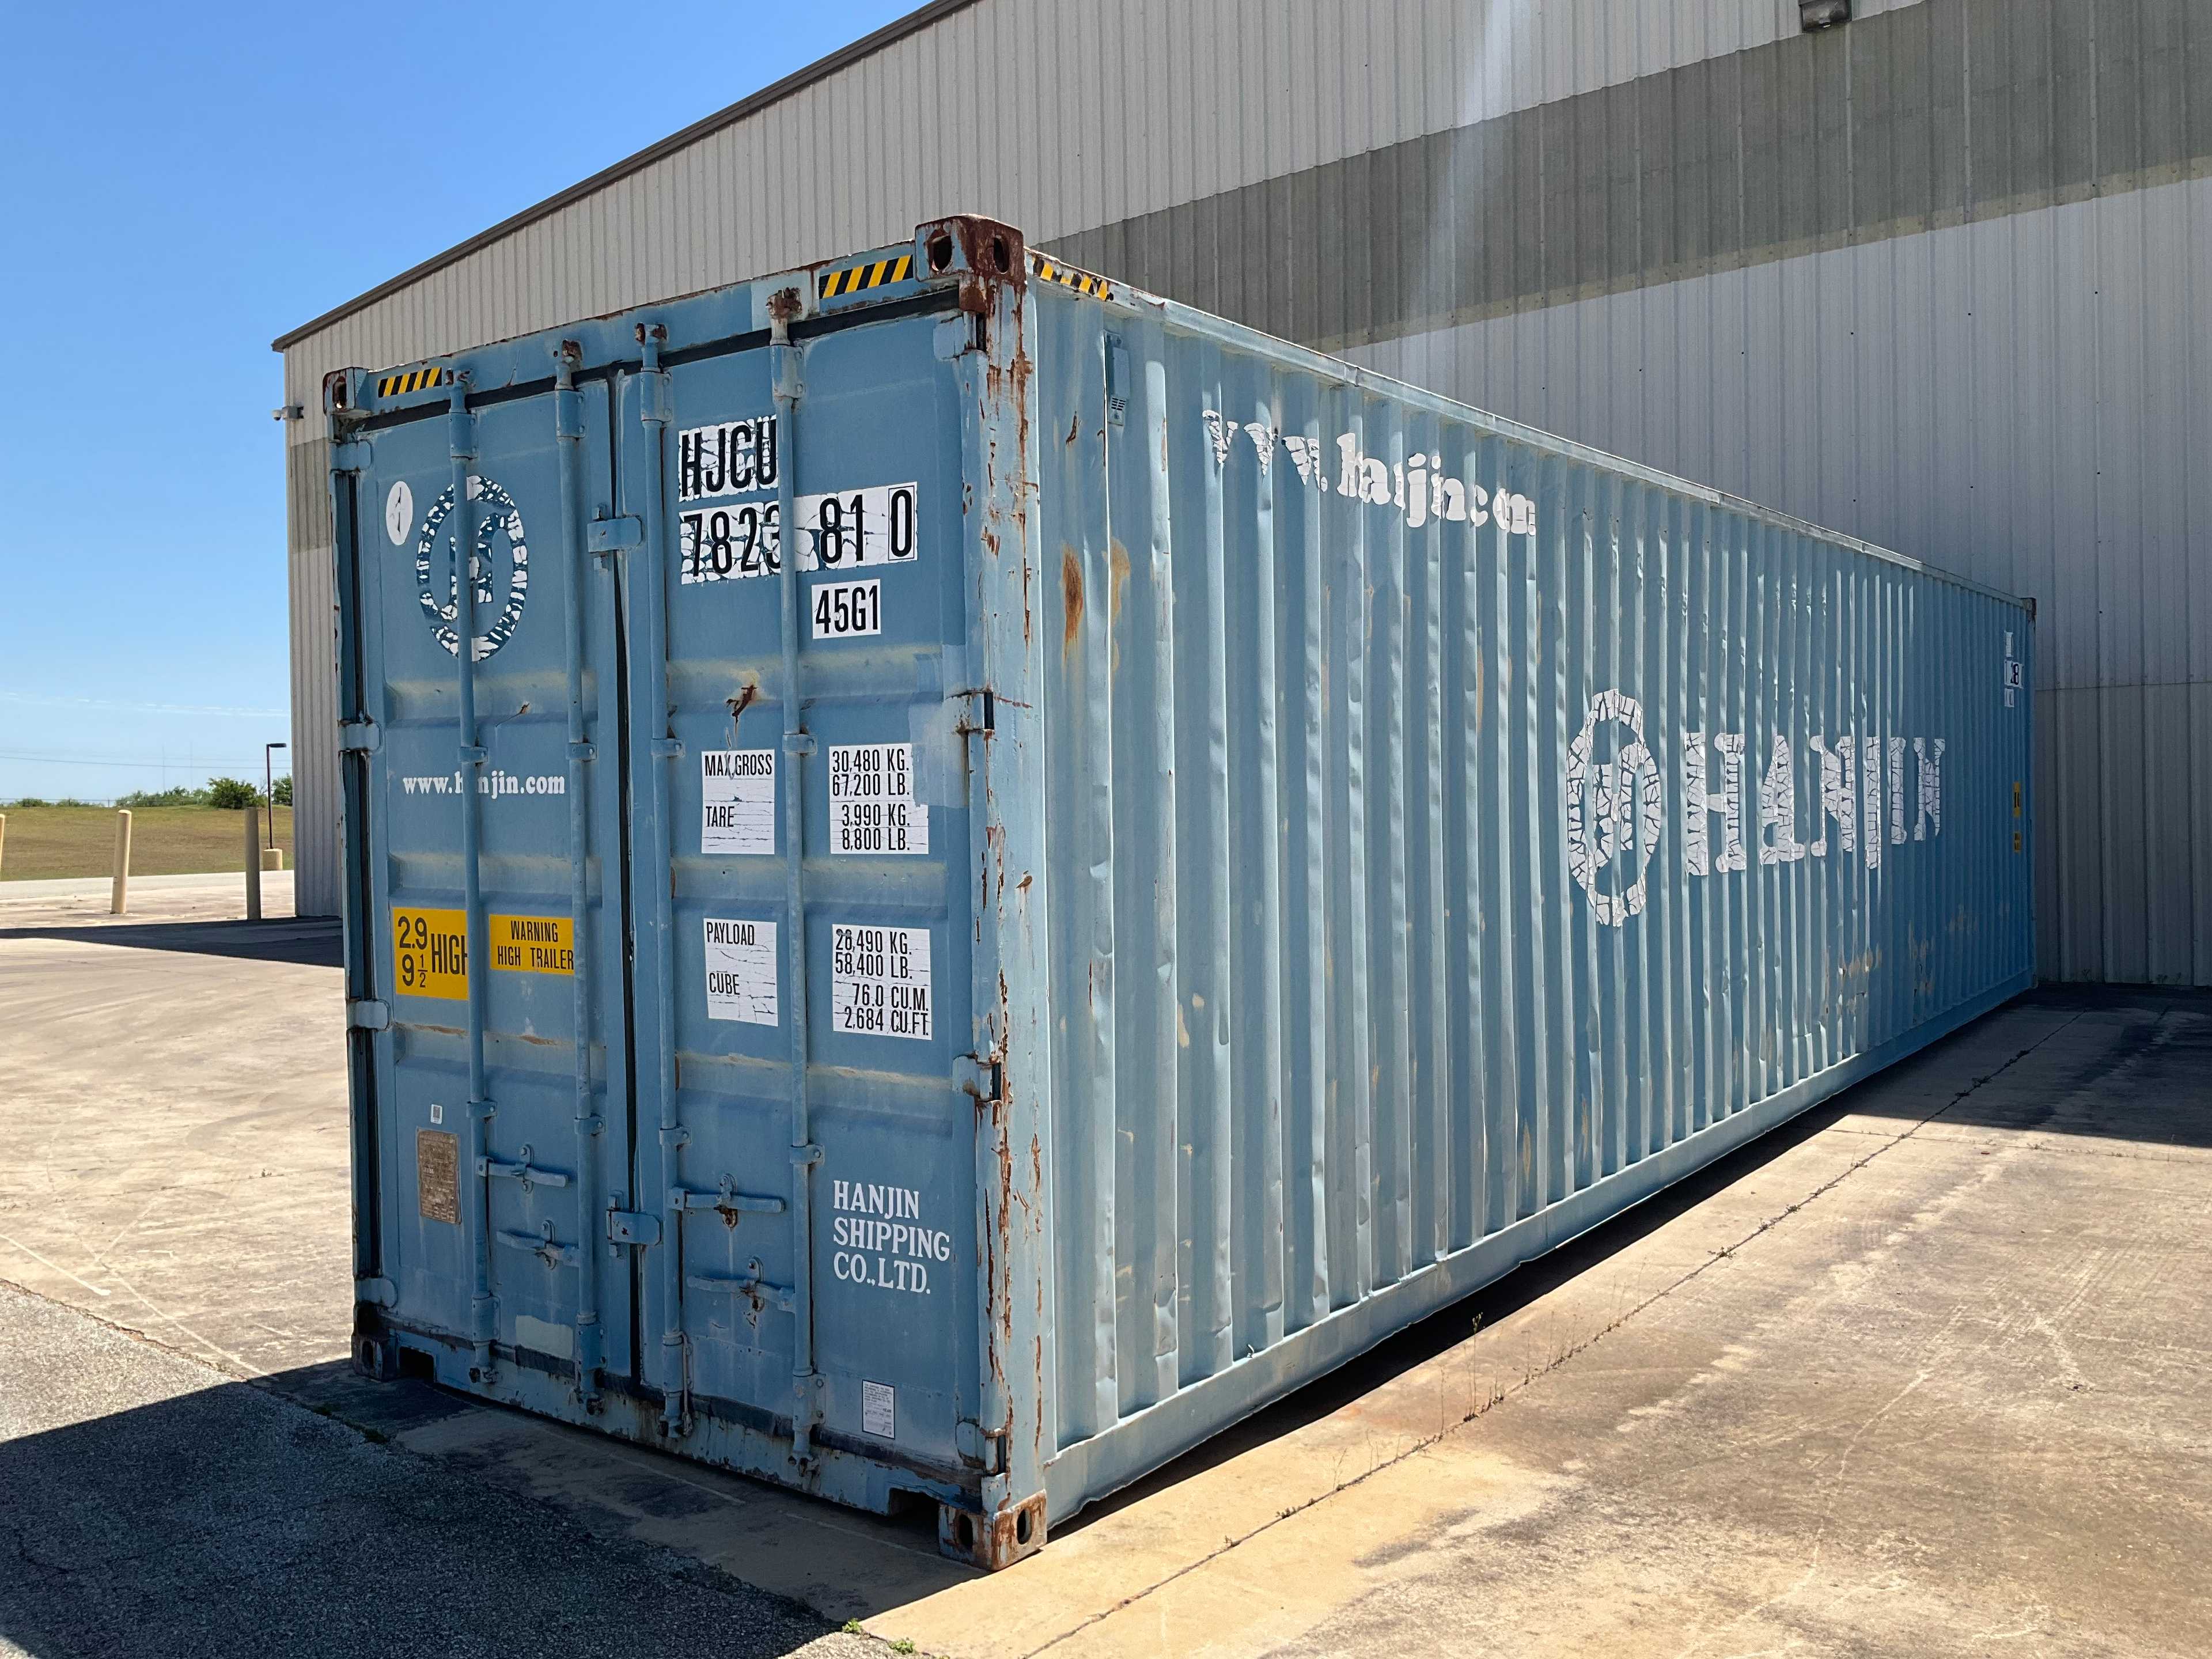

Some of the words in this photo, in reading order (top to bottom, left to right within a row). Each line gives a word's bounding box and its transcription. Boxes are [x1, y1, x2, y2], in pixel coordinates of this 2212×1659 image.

[681, 418, 777, 497] HJCU
[816, 585, 878, 634] 45G1
[832, 749, 880, 772] 30,480
[887, 748, 909, 771] KG.
[403, 770, 565, 799] www.hnjin.com
[832, 773, 880, 796] 67,200
[888, 772, 910, 796] LB.
[706, 806, 734, 827] TARE
[842, 804, 881, 827] 3,990
[888, 804, 910, 825] KG.
[842, 828, 881, 851] 8,800
[888, 828, 910, 850] LB.
[398, 916, 428, 949] 2.9
[510, 920, 558, 942] WARNING
[706, 922, 755, 945] PAYLOAD
[889, 931, 912, 955] KG.
[498, 945, 521, 966] HIGH
[530, 947, 574, 970] TRAILER
[835, 952, 884, 976] 58,400
[891, 955, 912, 979] LB.
[709, 972, 740, 995] CUBE
[852, 983, 884, 1007] 76.0
[891, 986, 929, 1012] CU.M.
[844, 1006, 883, 1031] 2,684
[891, 1009, 929, 1036] CU.FT.
[834, 1180, 919, 1219] HANJIN
[834, 1217, 950, 1262] SHIPPING
